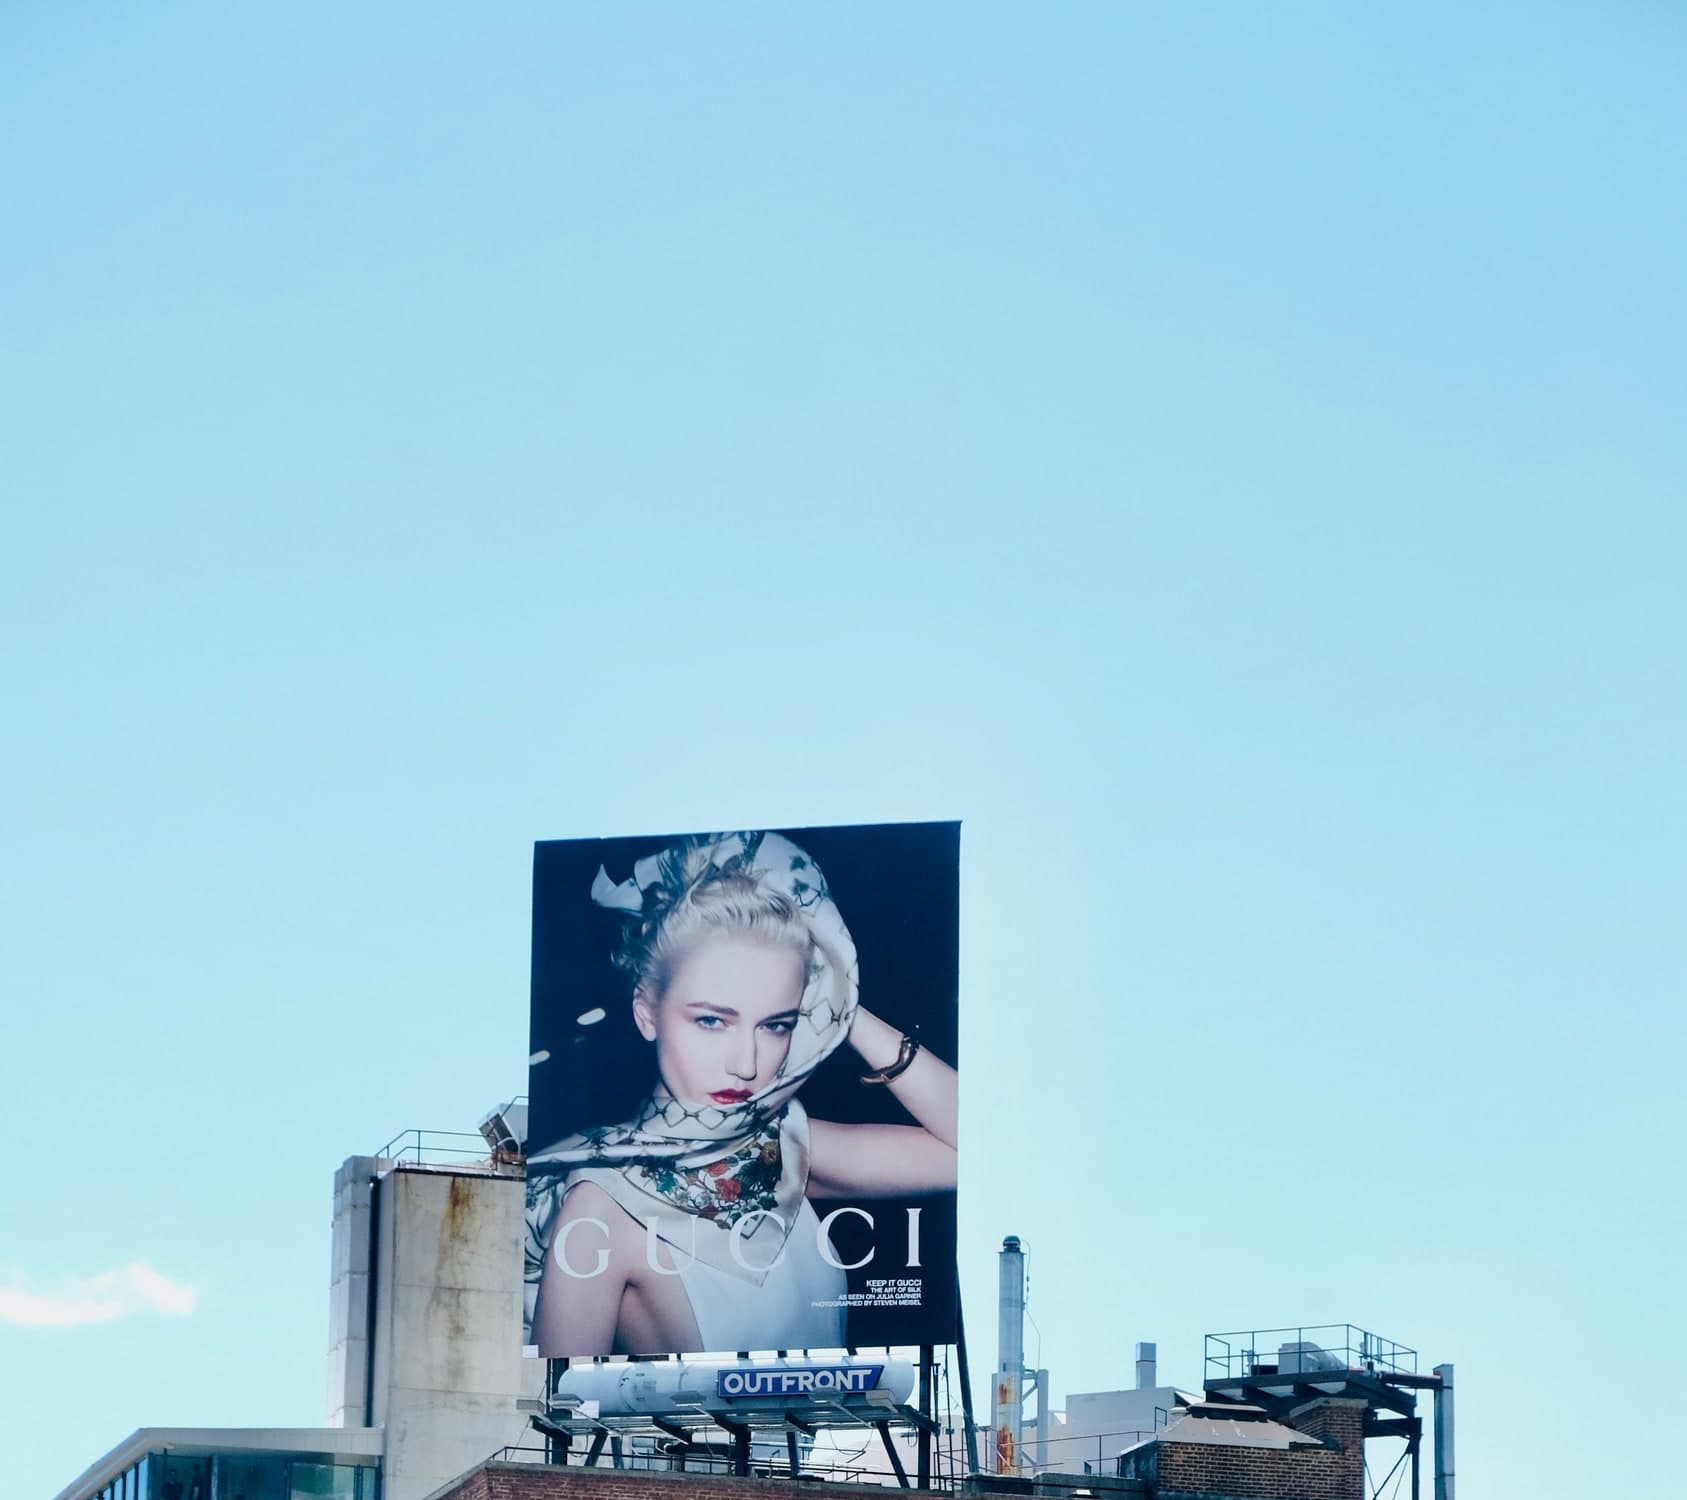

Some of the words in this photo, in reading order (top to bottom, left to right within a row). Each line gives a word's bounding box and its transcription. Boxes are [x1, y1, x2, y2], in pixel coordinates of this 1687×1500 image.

[553, 1207, 922, 1279] GUCCI
[888, 1279, 896, 1287] IT
[897, 1279, 922, 1287] GUCCI
[724, 1369, 872, 1394] OUTFRONT
